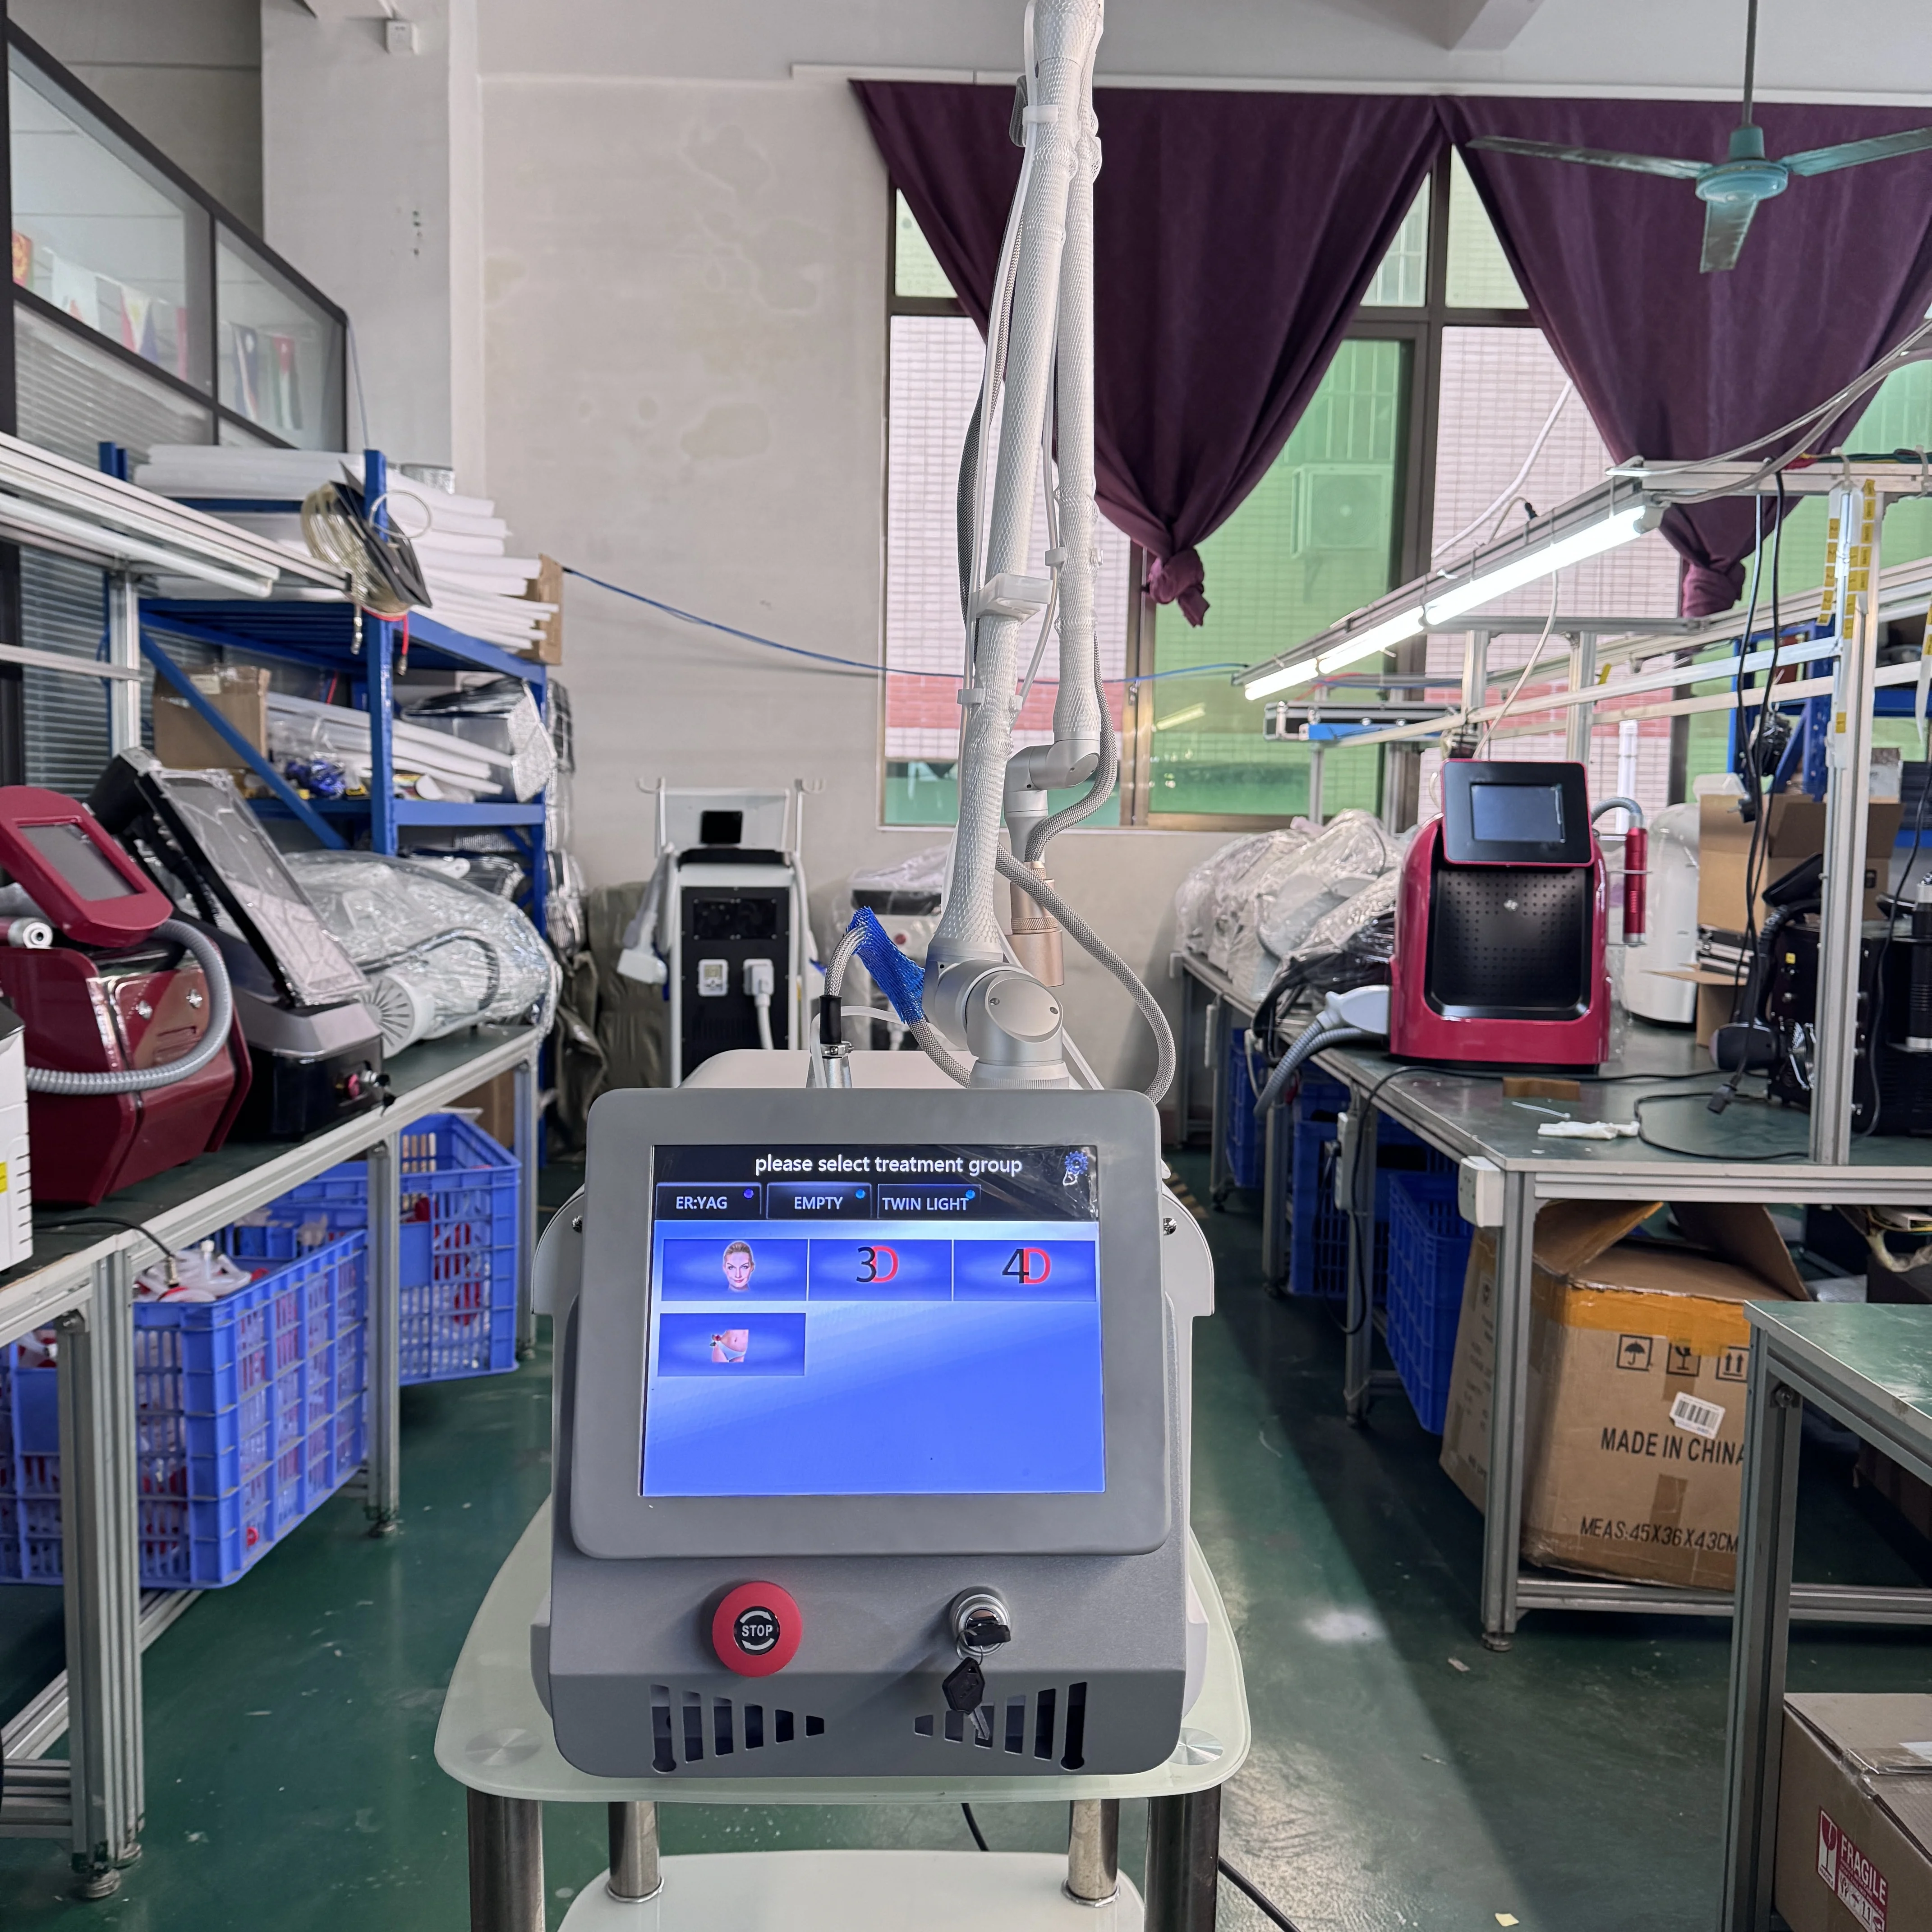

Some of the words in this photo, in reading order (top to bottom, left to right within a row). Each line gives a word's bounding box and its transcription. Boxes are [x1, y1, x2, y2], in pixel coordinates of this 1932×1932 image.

[755, 1154, 813, 1176] please
[818, 1154, 870, 1172] select
[875, 1156, 963, 1173] treatment
[968, 1159, 1022, 1177] group
[676, 1196, 727, 1209] ER:YAG
[794, 1196, 843, 1210] EMPTY
[882, 1197, 921, 1210] TWIN
[927, 1197, 969, 1210] LIGHT
[856, 1245, 899, 1283] 3D
[1002, 1247, 1051, 1284] 4D
[1601, 1427, 1659, 1457] MADE
[1662, 1434, 1684, 1460] IN
[741, 1624, 773, 1637] STOP
[1840, 1834, 1887, 1906] FRAGILE
